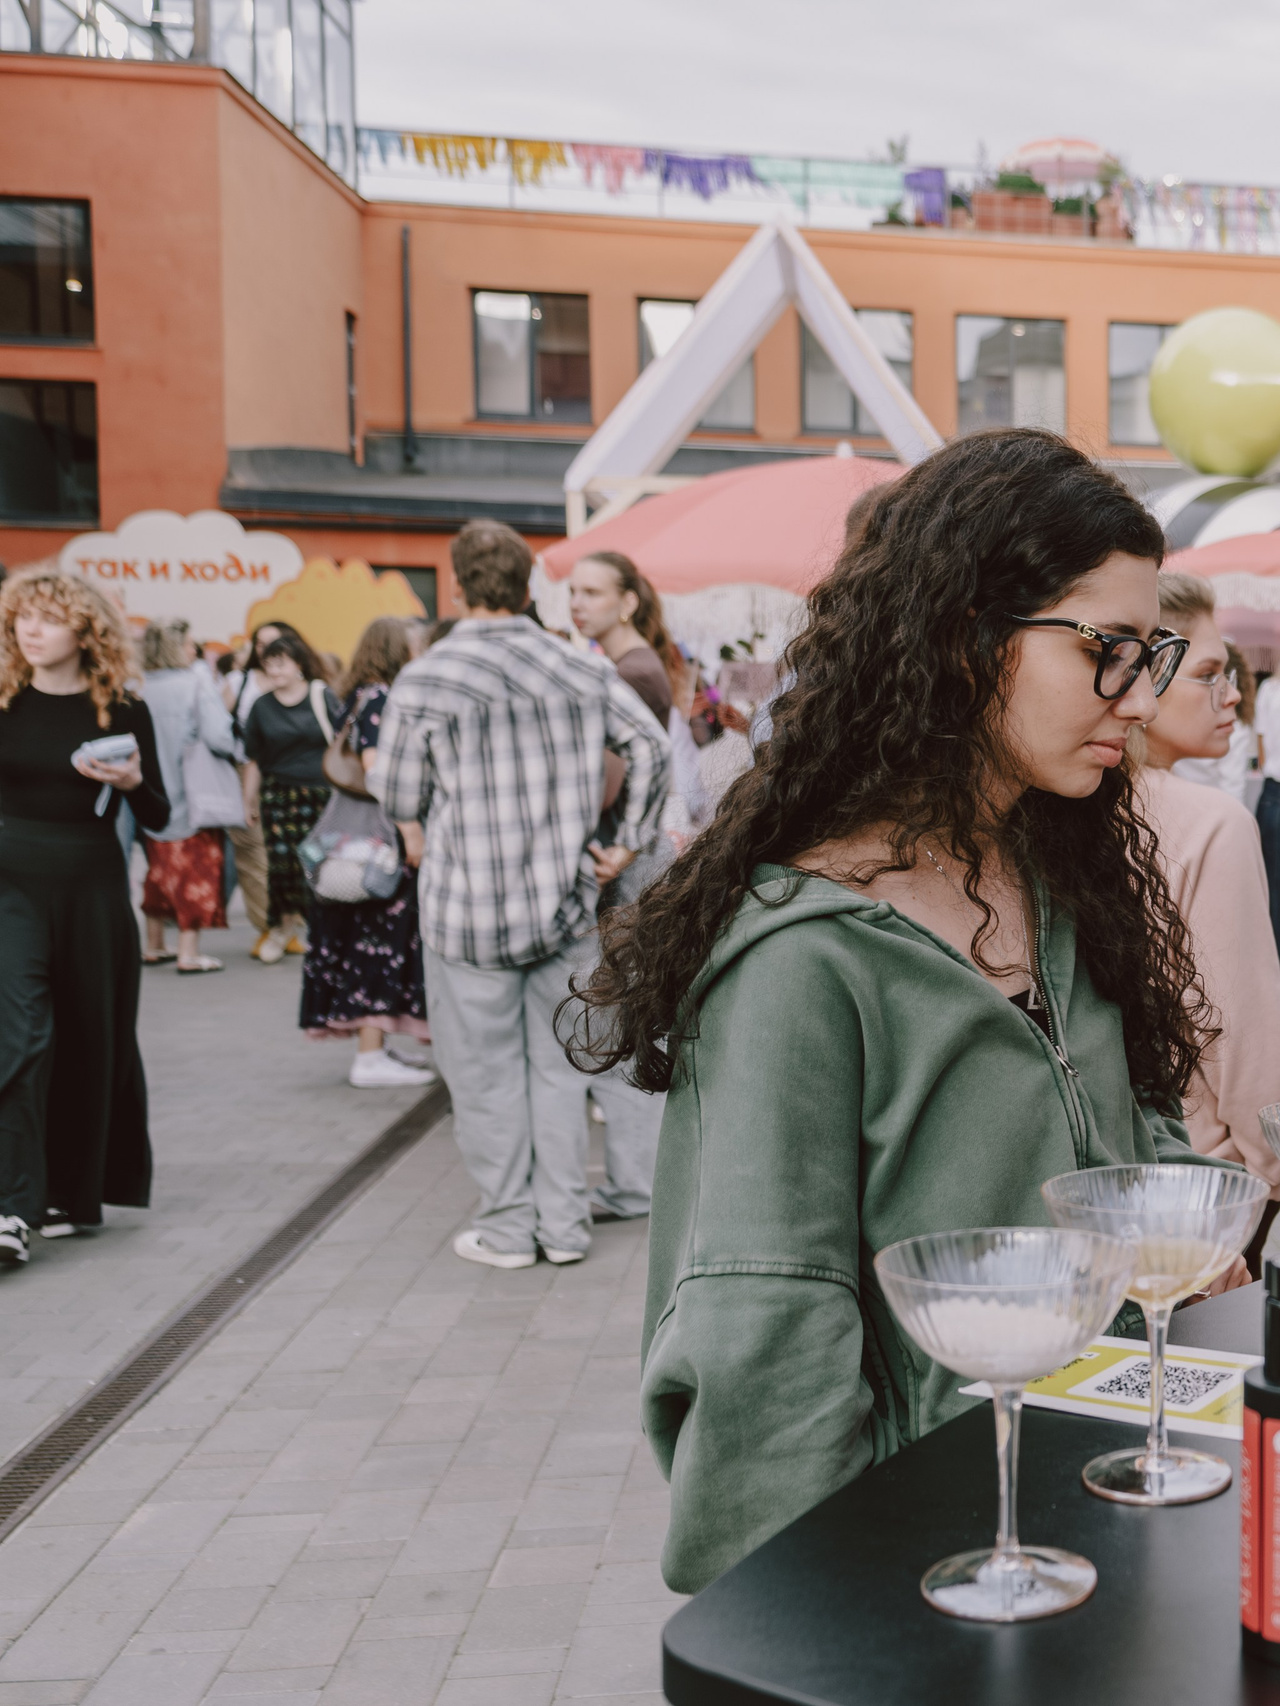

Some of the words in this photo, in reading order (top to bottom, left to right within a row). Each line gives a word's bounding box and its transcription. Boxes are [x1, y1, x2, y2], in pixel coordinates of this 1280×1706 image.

[75, 556, 140, 581] так
[148, 559, 170, 581] и
[179, 550, 271, 583] ходи
